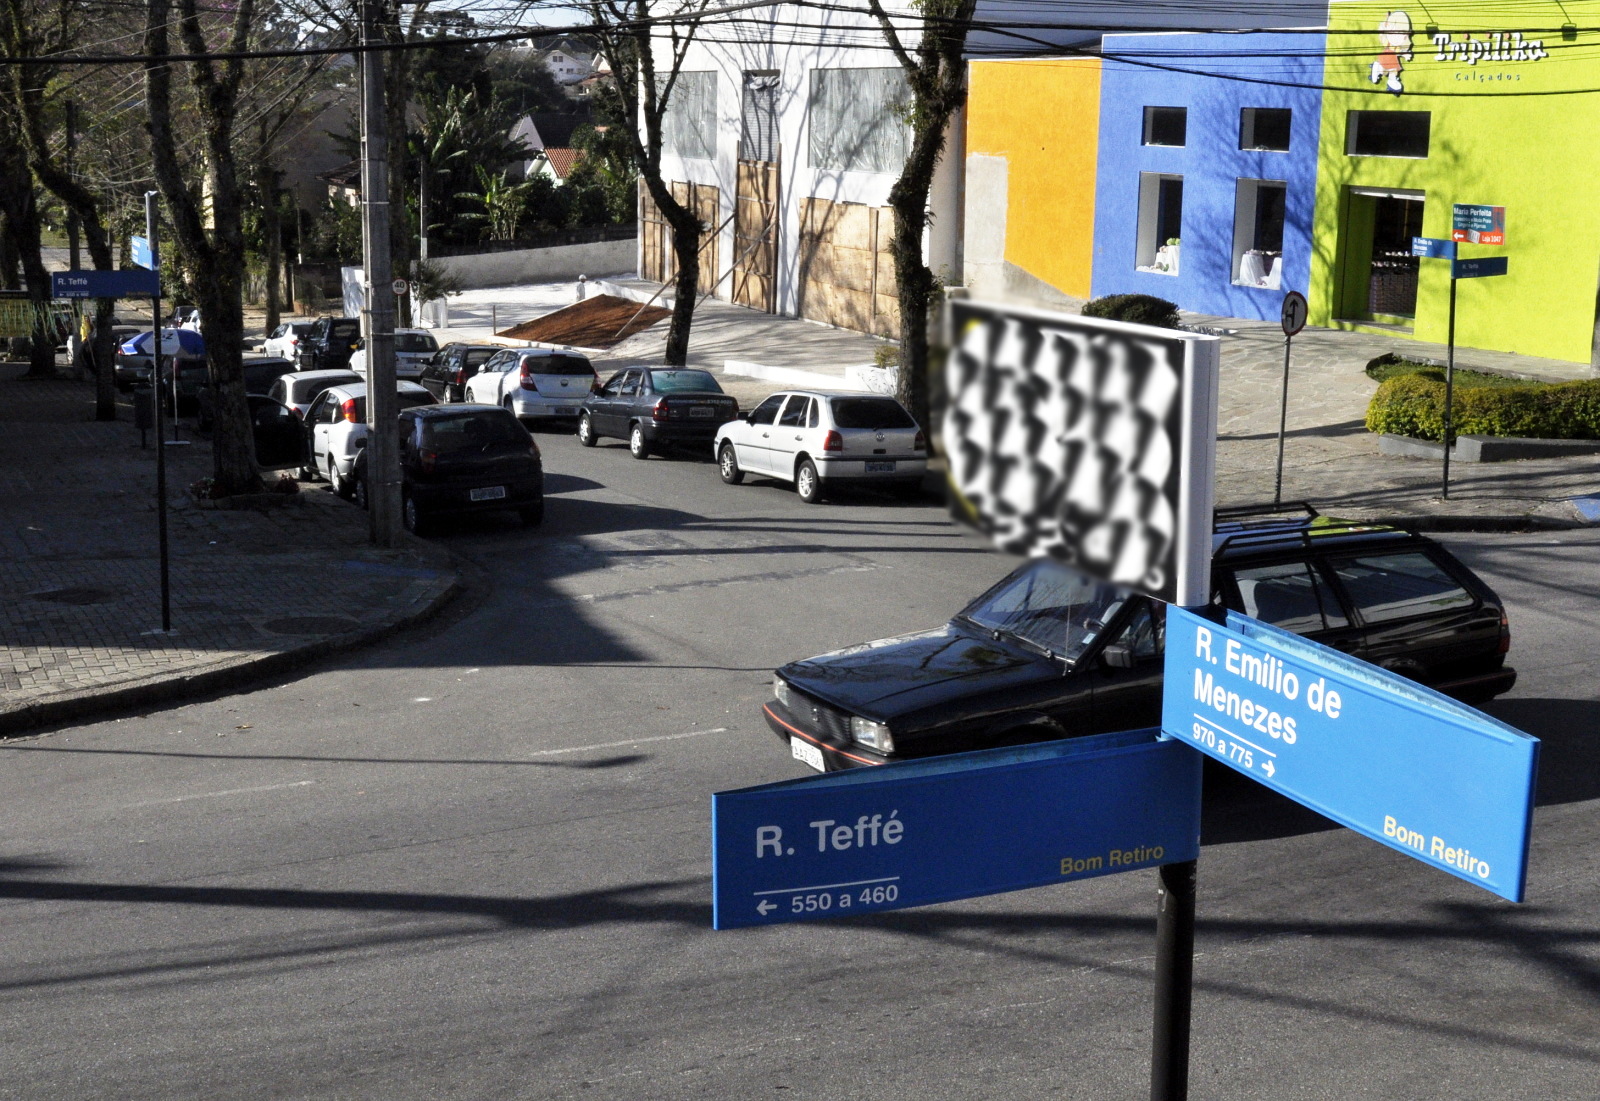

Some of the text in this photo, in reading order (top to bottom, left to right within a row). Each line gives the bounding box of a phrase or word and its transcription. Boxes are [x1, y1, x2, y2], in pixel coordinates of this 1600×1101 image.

[1433, 32, 1548, 65] Tripilika
[1455, 71, 1521, 83] Calçados
[57, 277, 88, 286] R. Teffé
[1196, 625, 1342, 719] R. Emílio de
[1194, 668, 1297, 745] Menezes
[1192, 722, 1253, 768] 970 a 775
[756, 809, 904, 858] R. Teffé
[1383, 815, 1490, 878] Bom Retiro
[1061, 844, 1164, 875] Bom Retiro
[791, 884, 898, 913] 550 a 460
